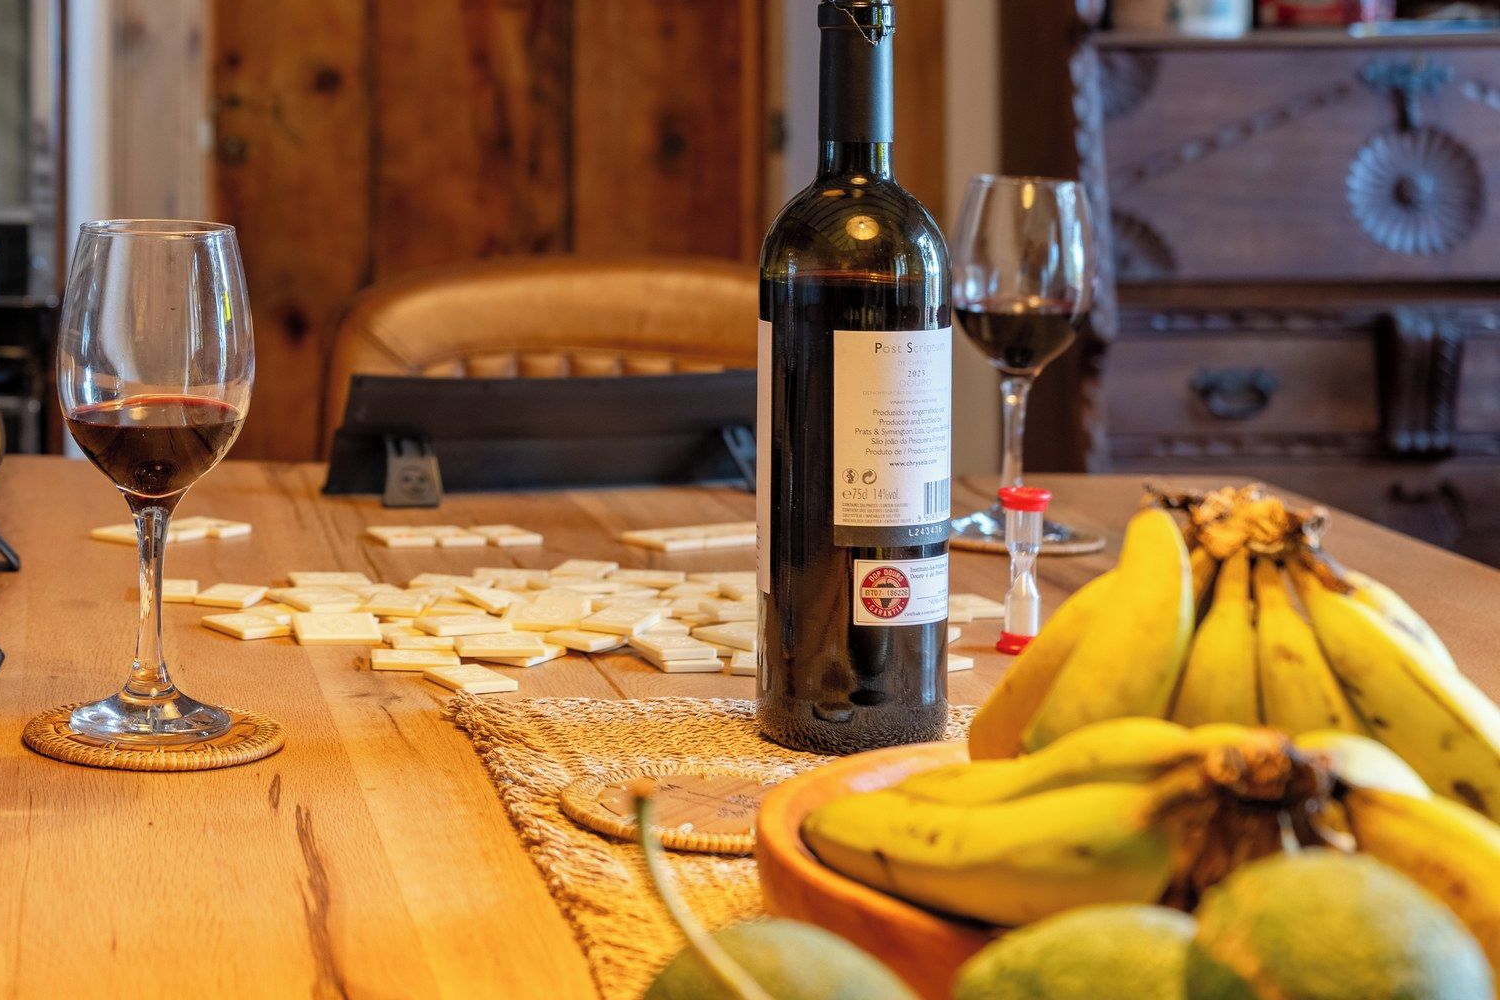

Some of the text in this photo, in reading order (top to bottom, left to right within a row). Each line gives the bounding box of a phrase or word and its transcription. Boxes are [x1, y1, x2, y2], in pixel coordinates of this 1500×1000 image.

[875, 341, 946, 358] Post Scriptum
[907, 369, 926, 378] 2023
[872, 408, 905, 416] Produzido
[878, 418, 908, 426] Produced
[854, 427, 872, 435] Prats
[871, 437, 883, 445] São
[884, 437, 899, 446] João
[900, 437, 908, 445] da
[865, 447, 892, 456] Produto
[894, 448, 902, 456] de
[907, 447, 928, 455] Product
[908, 524, 943, 538] L243436
[868, 569, 904, 582] DOP DOURO
[868, 604, 903, 617] GARANTIA
